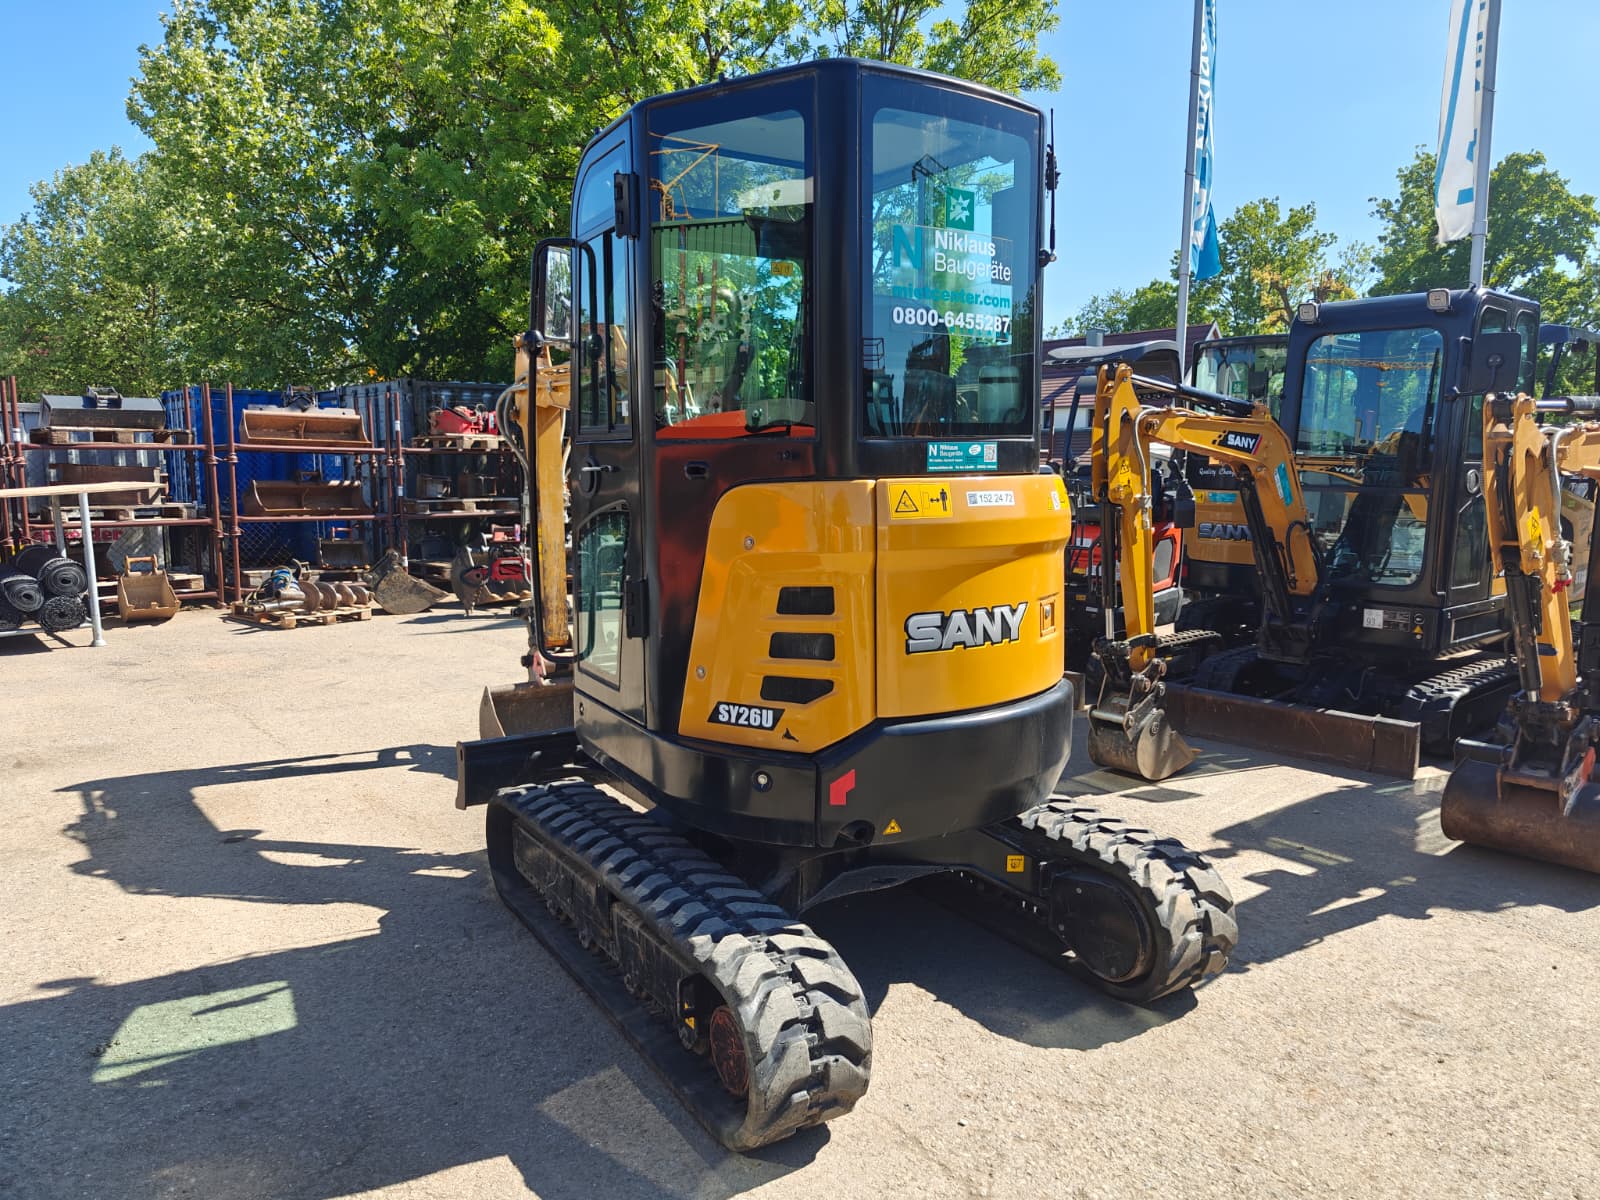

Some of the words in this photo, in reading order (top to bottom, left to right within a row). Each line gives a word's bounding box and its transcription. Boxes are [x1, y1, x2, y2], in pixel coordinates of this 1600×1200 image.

[893, 224, 923, 271] N
[934, 229, 996, 257] Niklaus
[934, 252, 1011, 281] Baugeräte
[892, 283, 1010, 308] mietcenter.com
[892, 306, 1010, 333] 0800-6455287
[929, 445, 937, 456] N
[1227, 433, 1256, 449] SANY
[979, 493, 993, 503] 152
[994, 493, 1004, 503] 24
[904, 602, 1028, 655] SANY
[718, 703, 774, 728] SY26U
